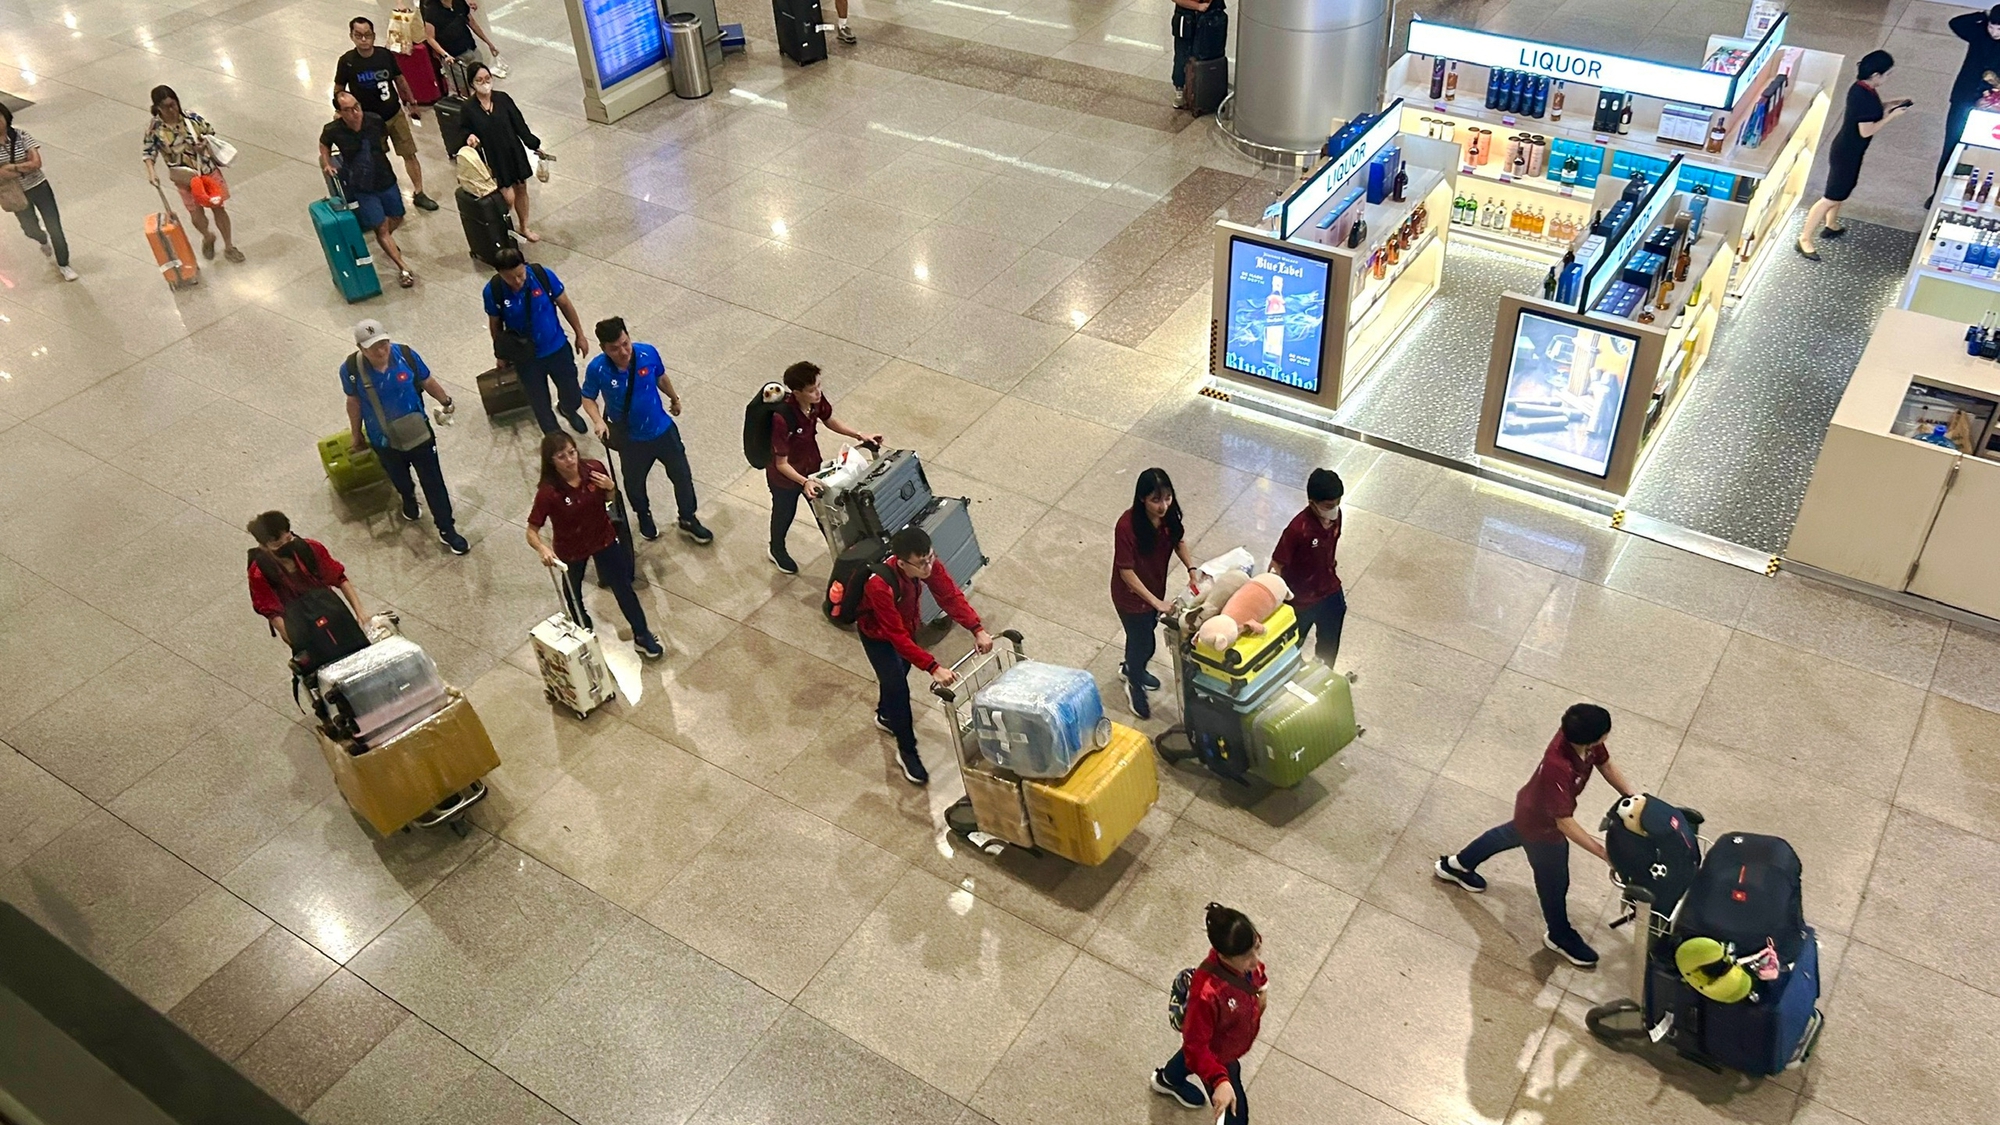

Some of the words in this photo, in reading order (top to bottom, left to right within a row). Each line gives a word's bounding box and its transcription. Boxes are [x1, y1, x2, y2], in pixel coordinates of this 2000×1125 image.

[356, 69, 390, 83] HUGO
[1519, 47, 1603, 79] LIQUOR
[376, 81, 390, 102] 3
[1326, 142, 1367, 192] LIQUOR
[1618, 205, 1653, 261] LIQUOR
[1255, 256, 1278, 272] Blue
[1276, 261, 1304, 278] Label
